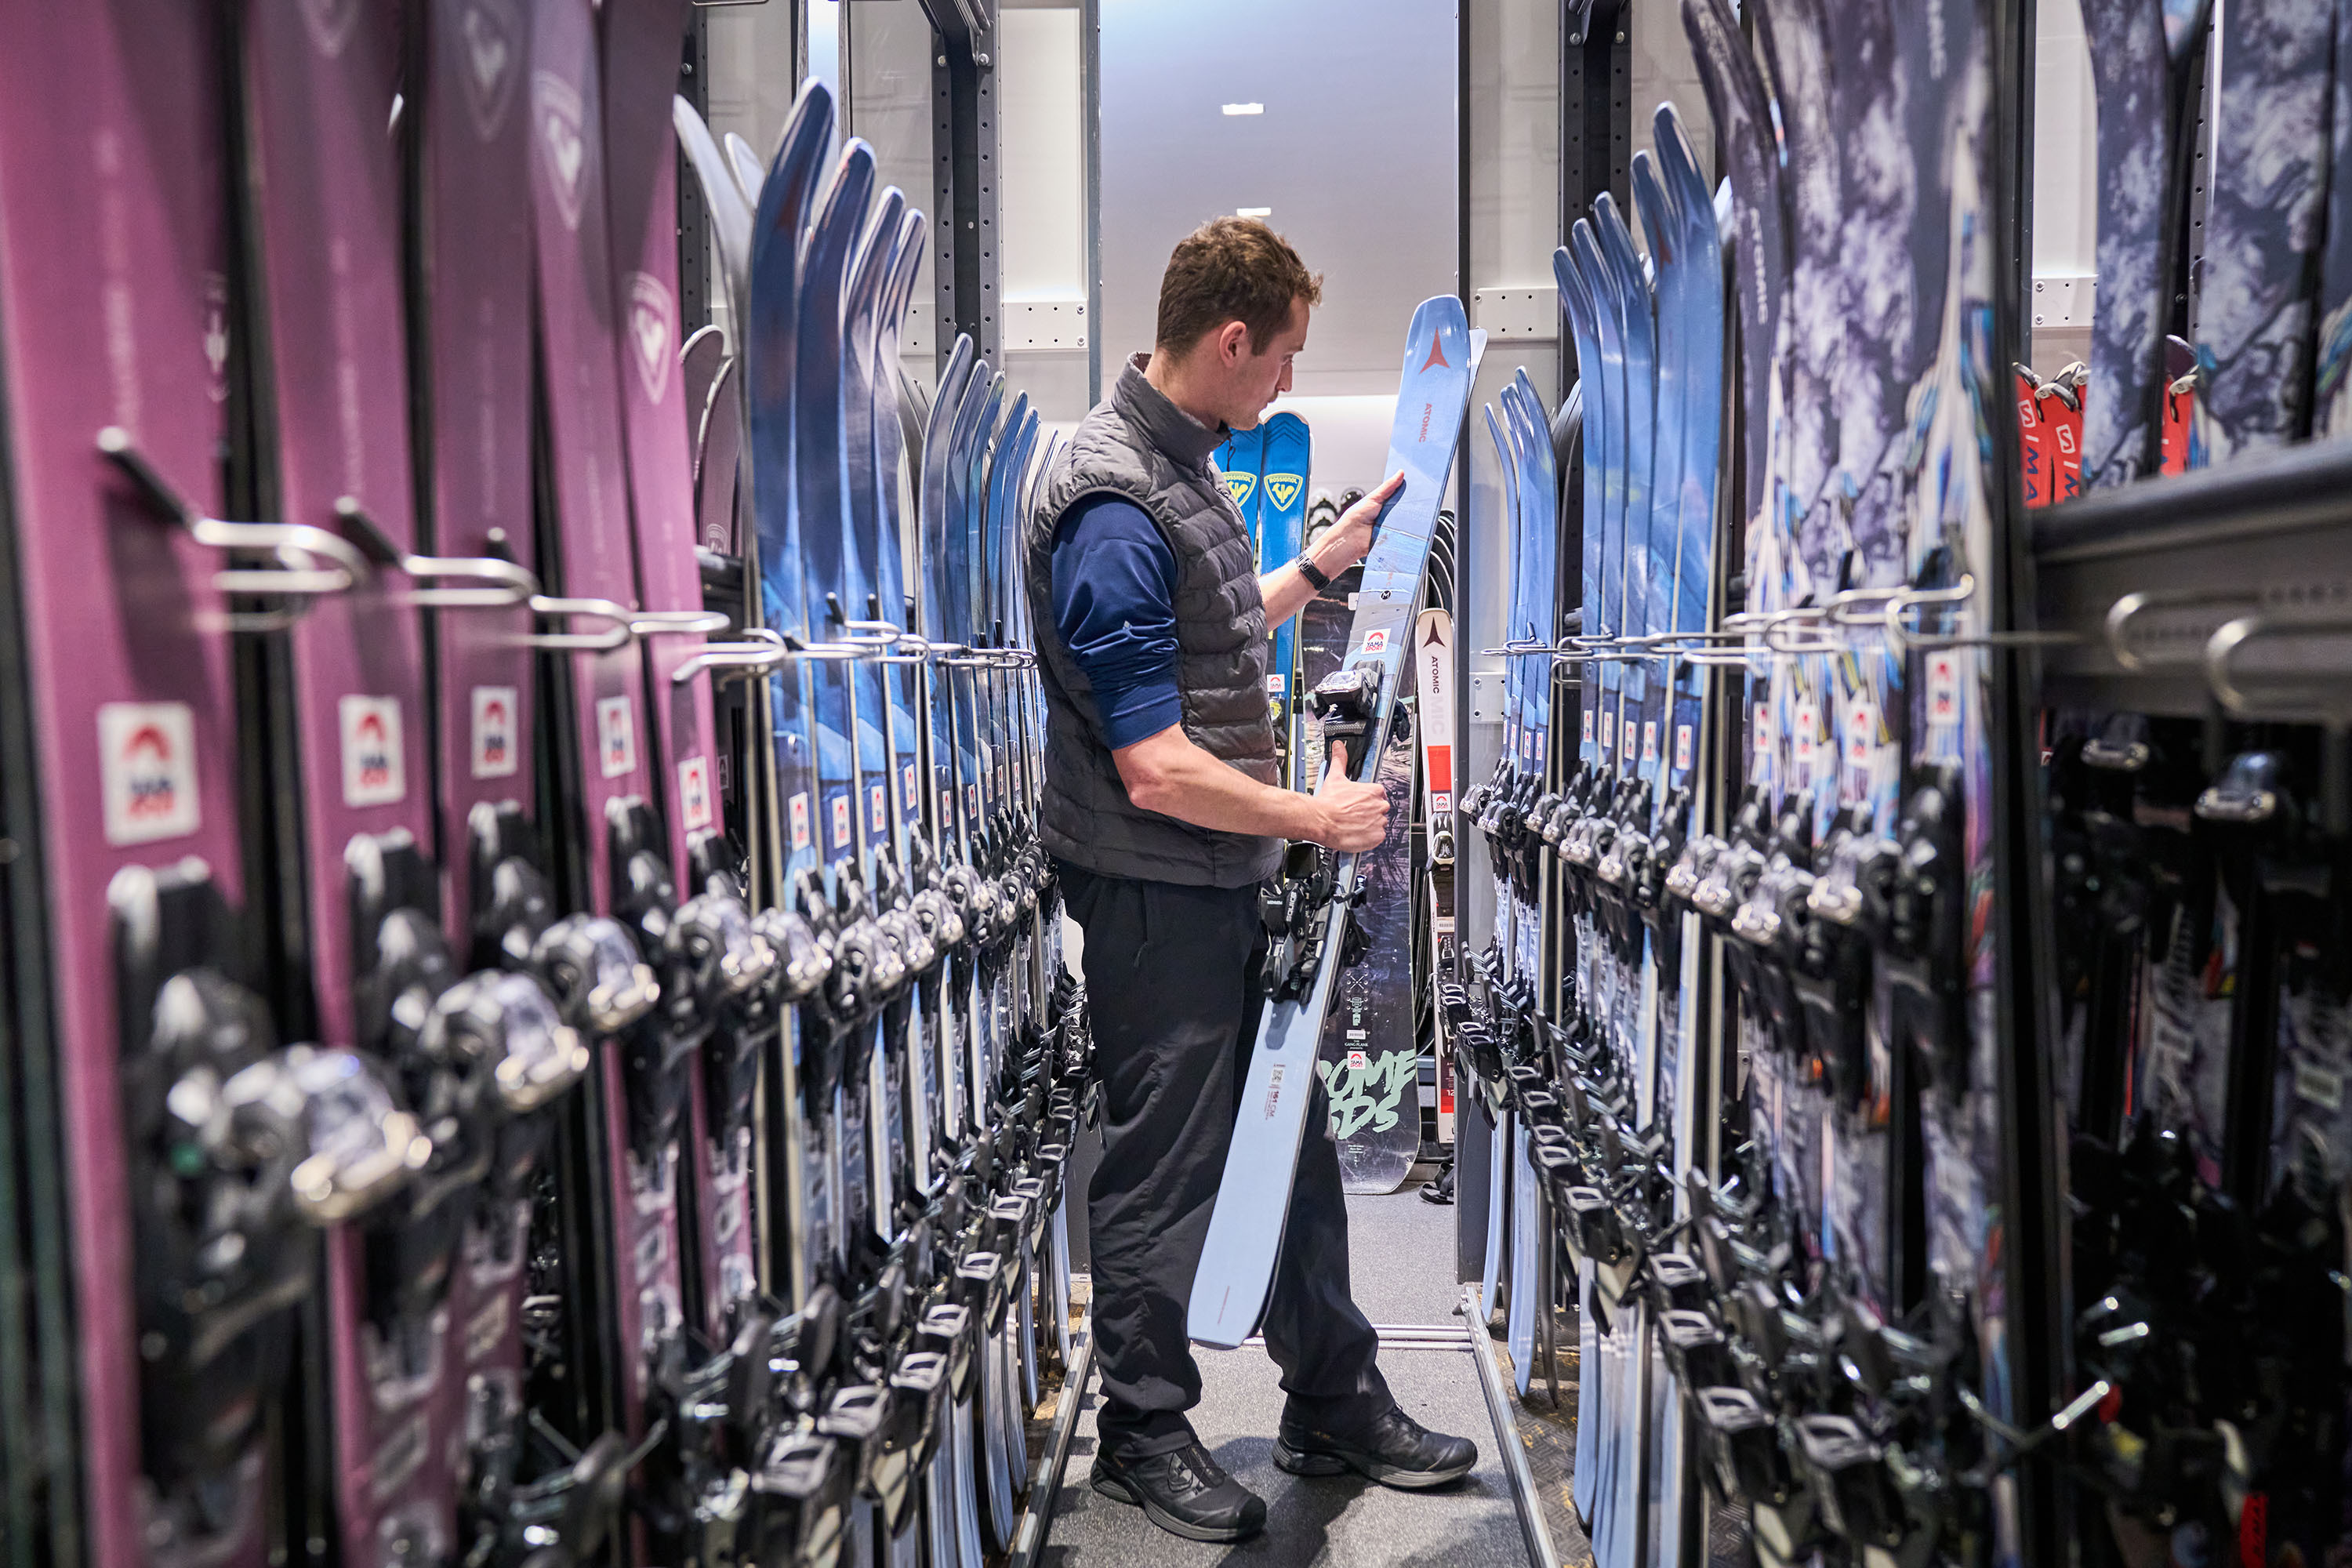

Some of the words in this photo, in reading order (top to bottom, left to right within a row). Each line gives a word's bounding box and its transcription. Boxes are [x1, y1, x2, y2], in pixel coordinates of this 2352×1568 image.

[1418, 403, 1432, 443] ATOMIC
[1432, 655, 1440, 694] ATOMIC
[1269, 1104, 1276, 1117] CM
